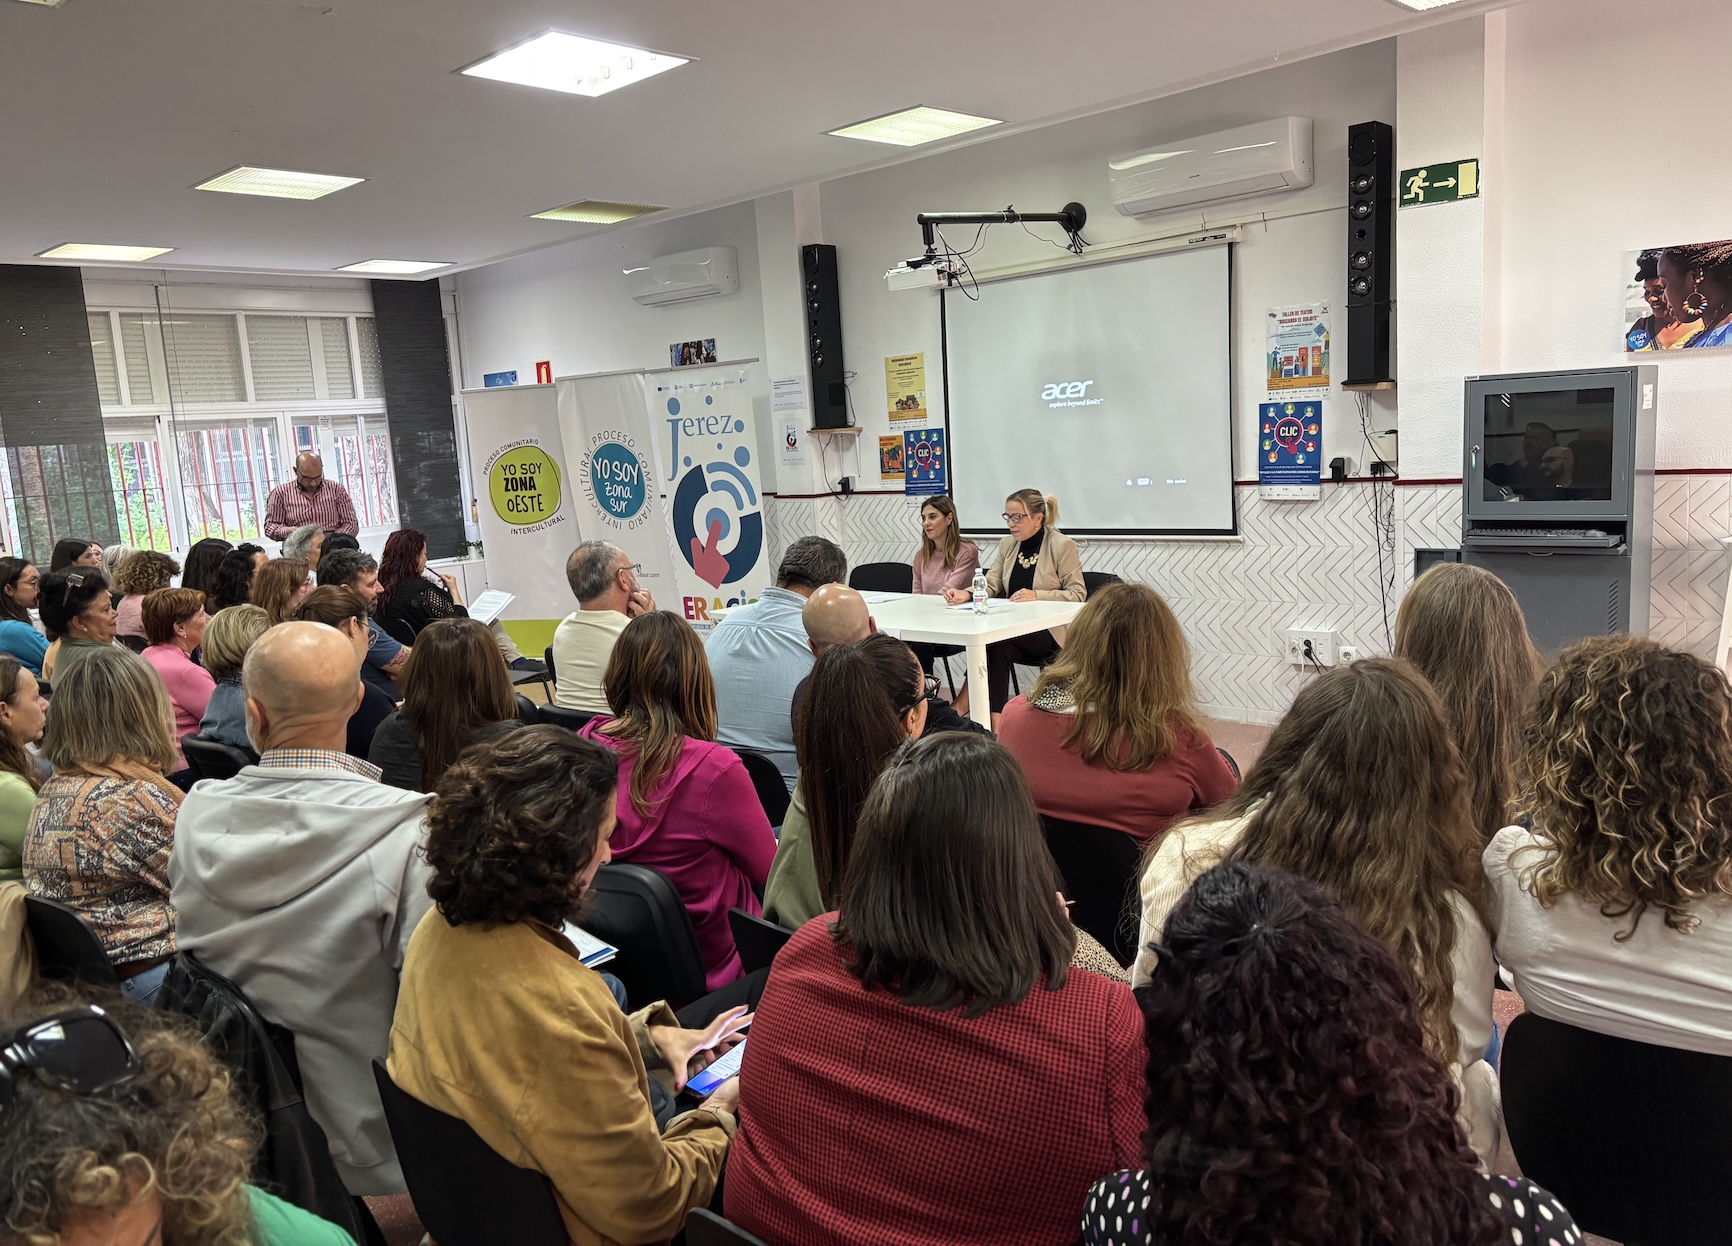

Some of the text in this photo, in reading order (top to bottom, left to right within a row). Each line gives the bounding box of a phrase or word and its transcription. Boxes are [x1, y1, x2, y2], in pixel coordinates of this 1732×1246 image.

[1041, 380, 1094, 400] acer
[1067, 400, 1086, 408] beyond
[666, 397, 734, 482] jerez
[1280, 426, 1298, 437] CLIC
[483, 438, 539, 476] PROCESO COMUNITARIO
[917, 448, 930, 457] CLIC
[501, 462, 542, 476] YO SOY
[593, 457, 639, 485] YO SOY
[503, 476, 537, 492] ZONA
[579, 447, 622, 530] INTERCULTURAL
[592, 430, 653, 530] PROCESO COMUNITARIO
[604, 482, 633, 499] zona
[609, 498, 628, 513] sur
[510, 514, 566, 535] INTERCULTURAL
